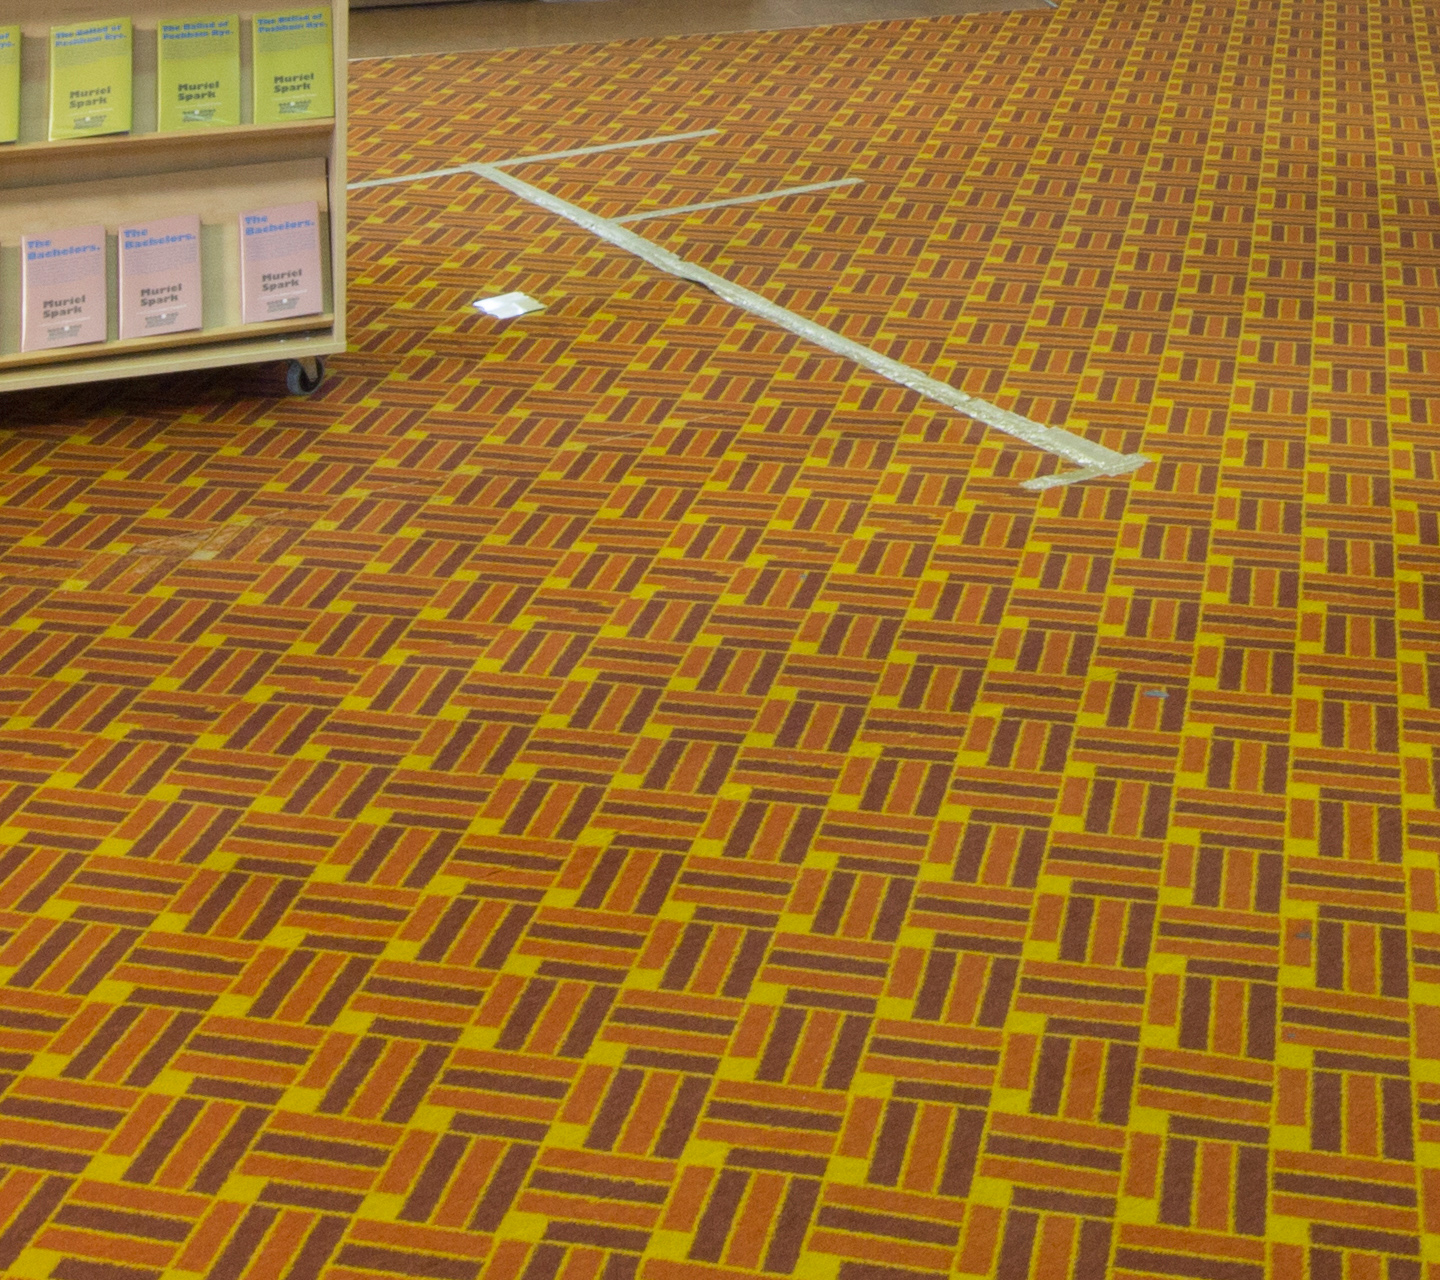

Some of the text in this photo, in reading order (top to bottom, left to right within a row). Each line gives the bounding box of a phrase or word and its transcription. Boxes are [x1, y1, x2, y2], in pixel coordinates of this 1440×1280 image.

[245, 212, 268, 225] The
[244, 218, 316, 237] Bachelors.
[261, 268, 303, 282] Muriel
[261, 278, 300, 292] Spark
